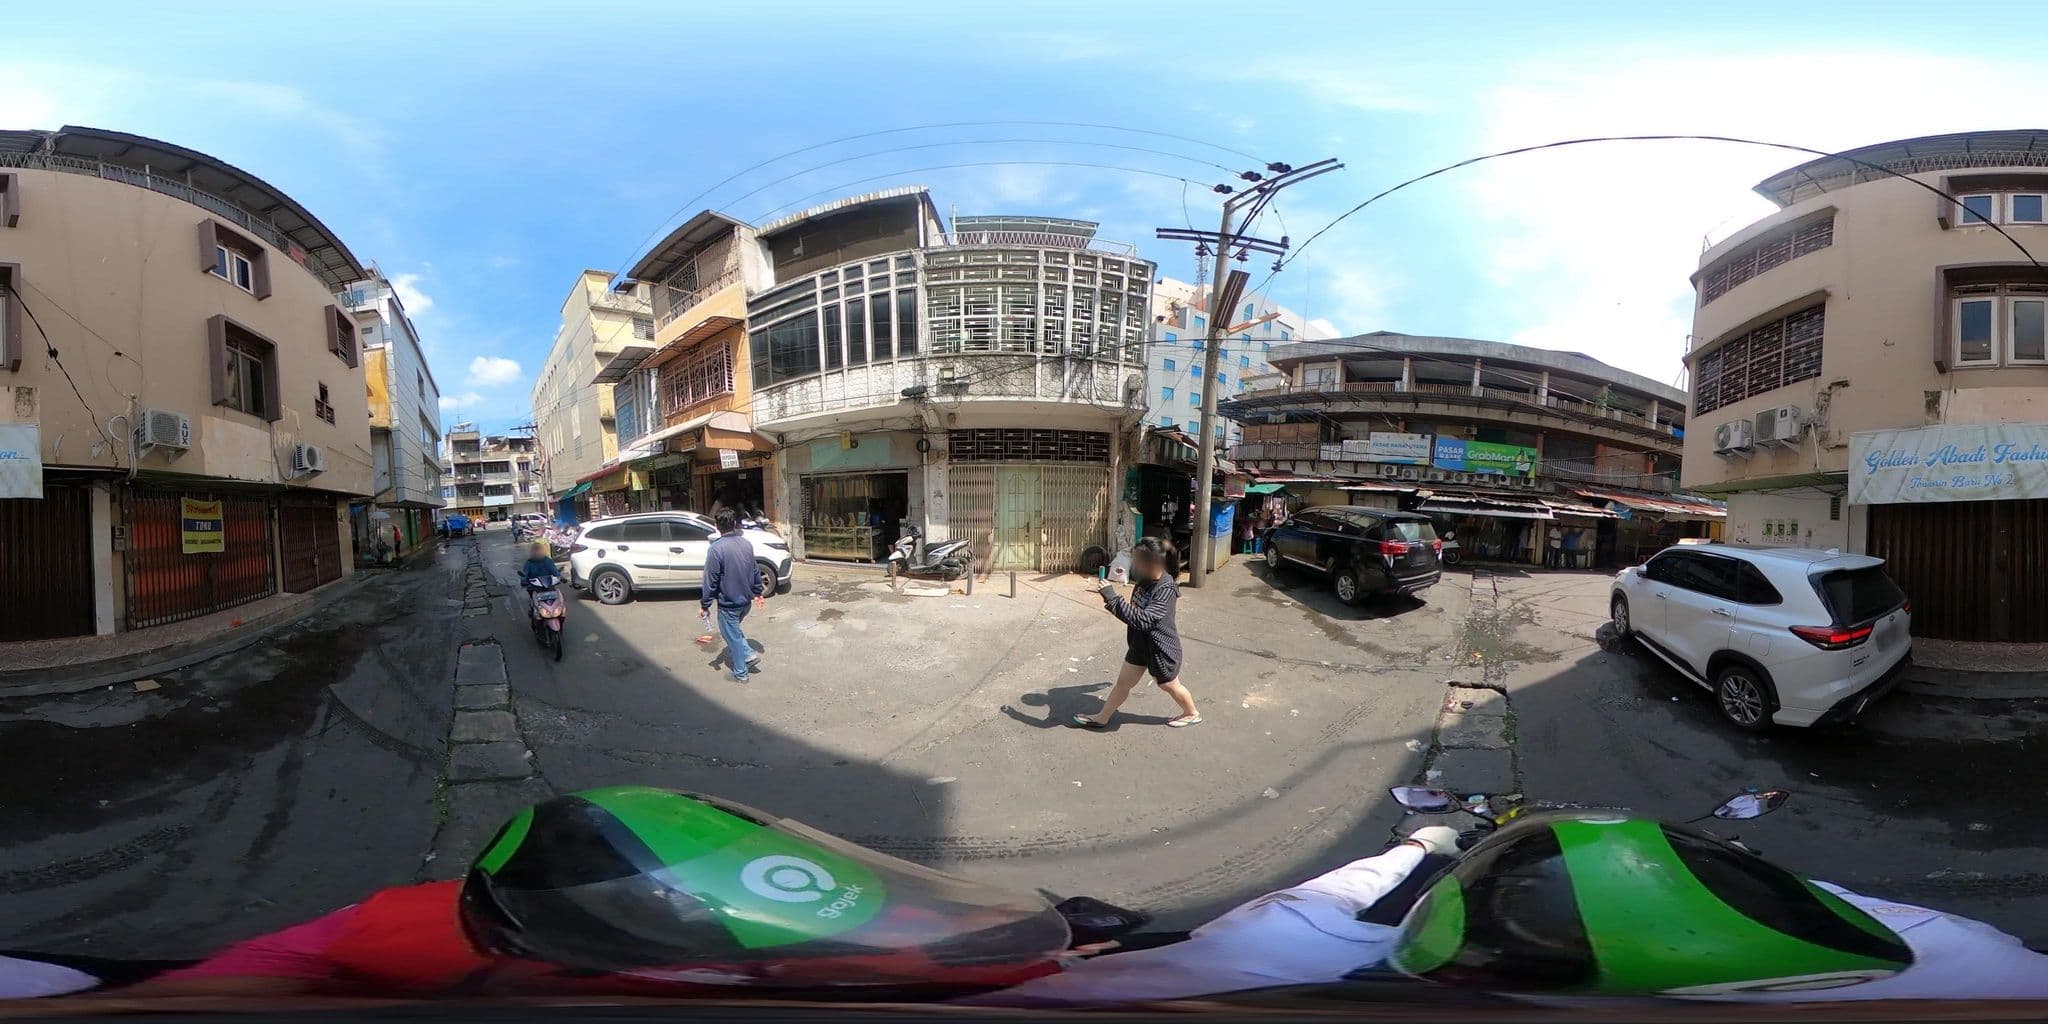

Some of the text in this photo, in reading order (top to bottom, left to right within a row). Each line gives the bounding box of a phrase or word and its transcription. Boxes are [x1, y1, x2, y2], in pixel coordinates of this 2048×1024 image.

[181, 422, 189, 445] AUX
[1438, 446, 1464, 455] PASAR
[1865, 450, 1920, 475] Golden
[1925, 444, 1986, 467] Abadi
[816, 884, 864, 919] gojek
